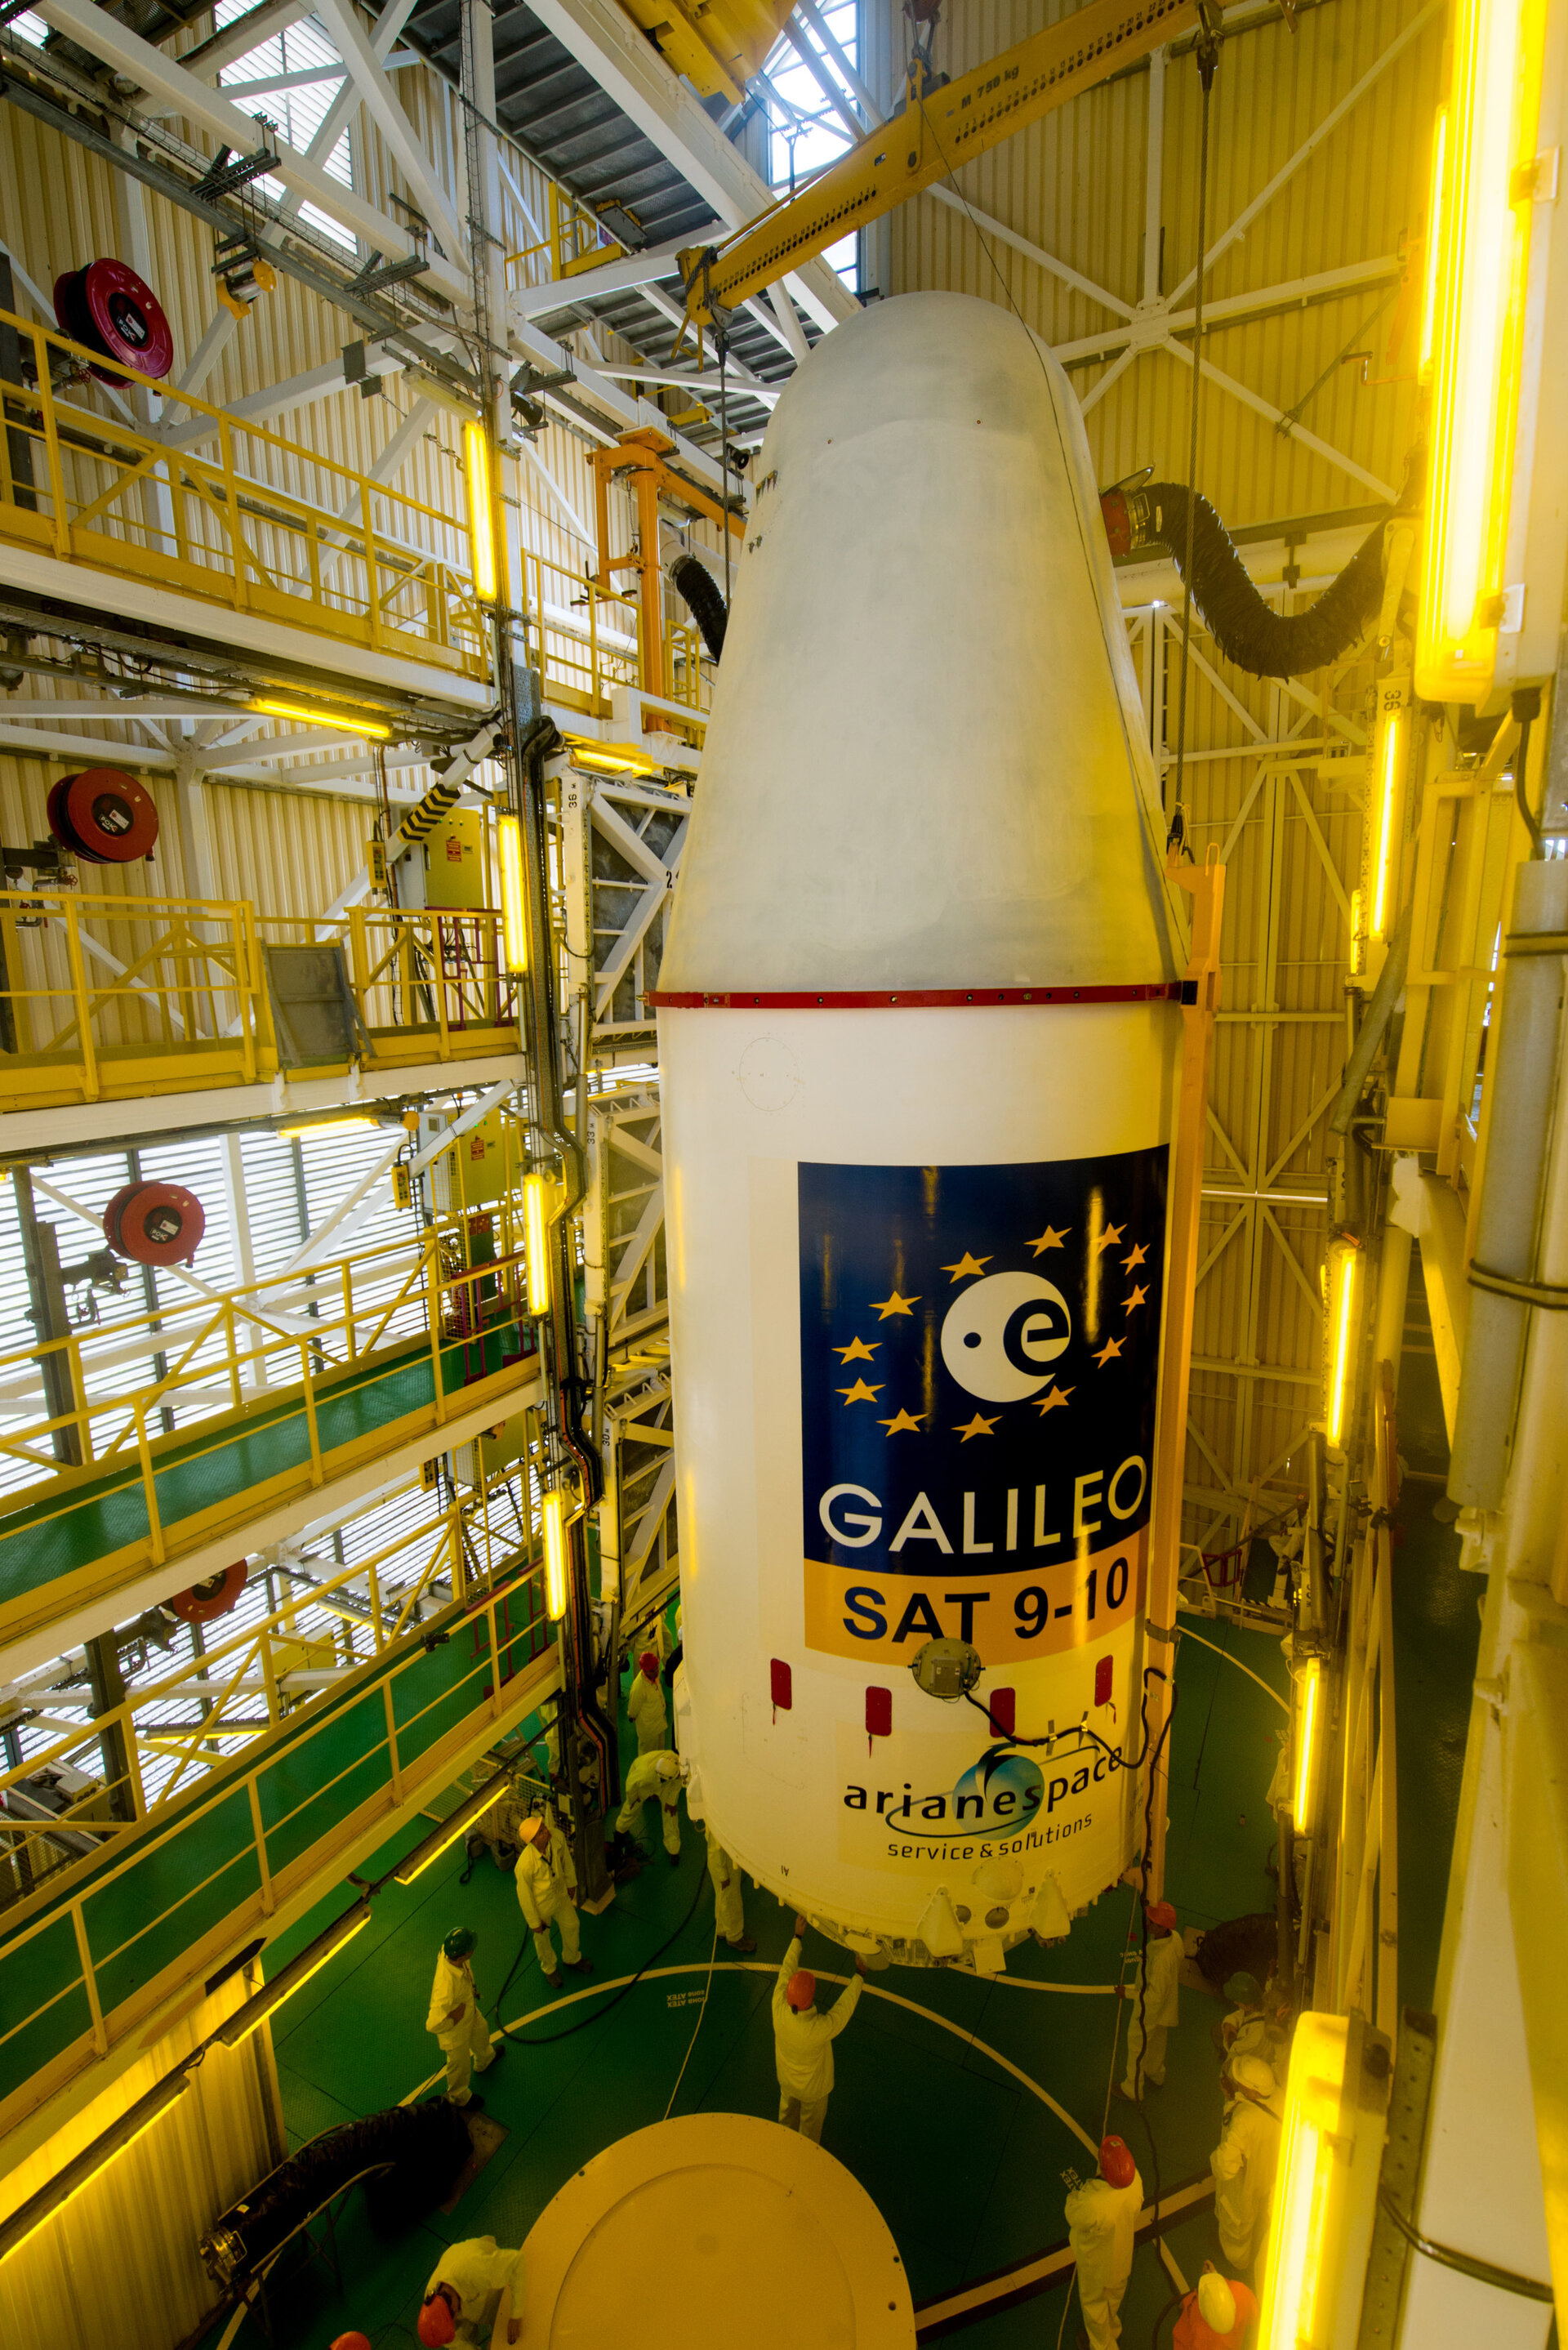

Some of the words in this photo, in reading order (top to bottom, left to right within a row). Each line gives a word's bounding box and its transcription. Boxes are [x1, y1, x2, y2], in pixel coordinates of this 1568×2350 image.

[977, 75, 1000, 99] 750
[1004, 65, 1019, 82] kg
[568, 793, 577, 809] 36
[586, 1131, 595, 1144] 33
[602, 1434, 610, 1447] 30
[819, 1455, 1147, 1554] GALILEO
[843, 1586, 991, 1645] SAT
[1013, 1557, 1129, 1639] 9-10
[844, 1746, 1123, 1819] arianespace
[887, 1842, 974, 1861] service
[979, 1843, 993, 1858] &
[998, 1813, 1093, 1857] solutions
